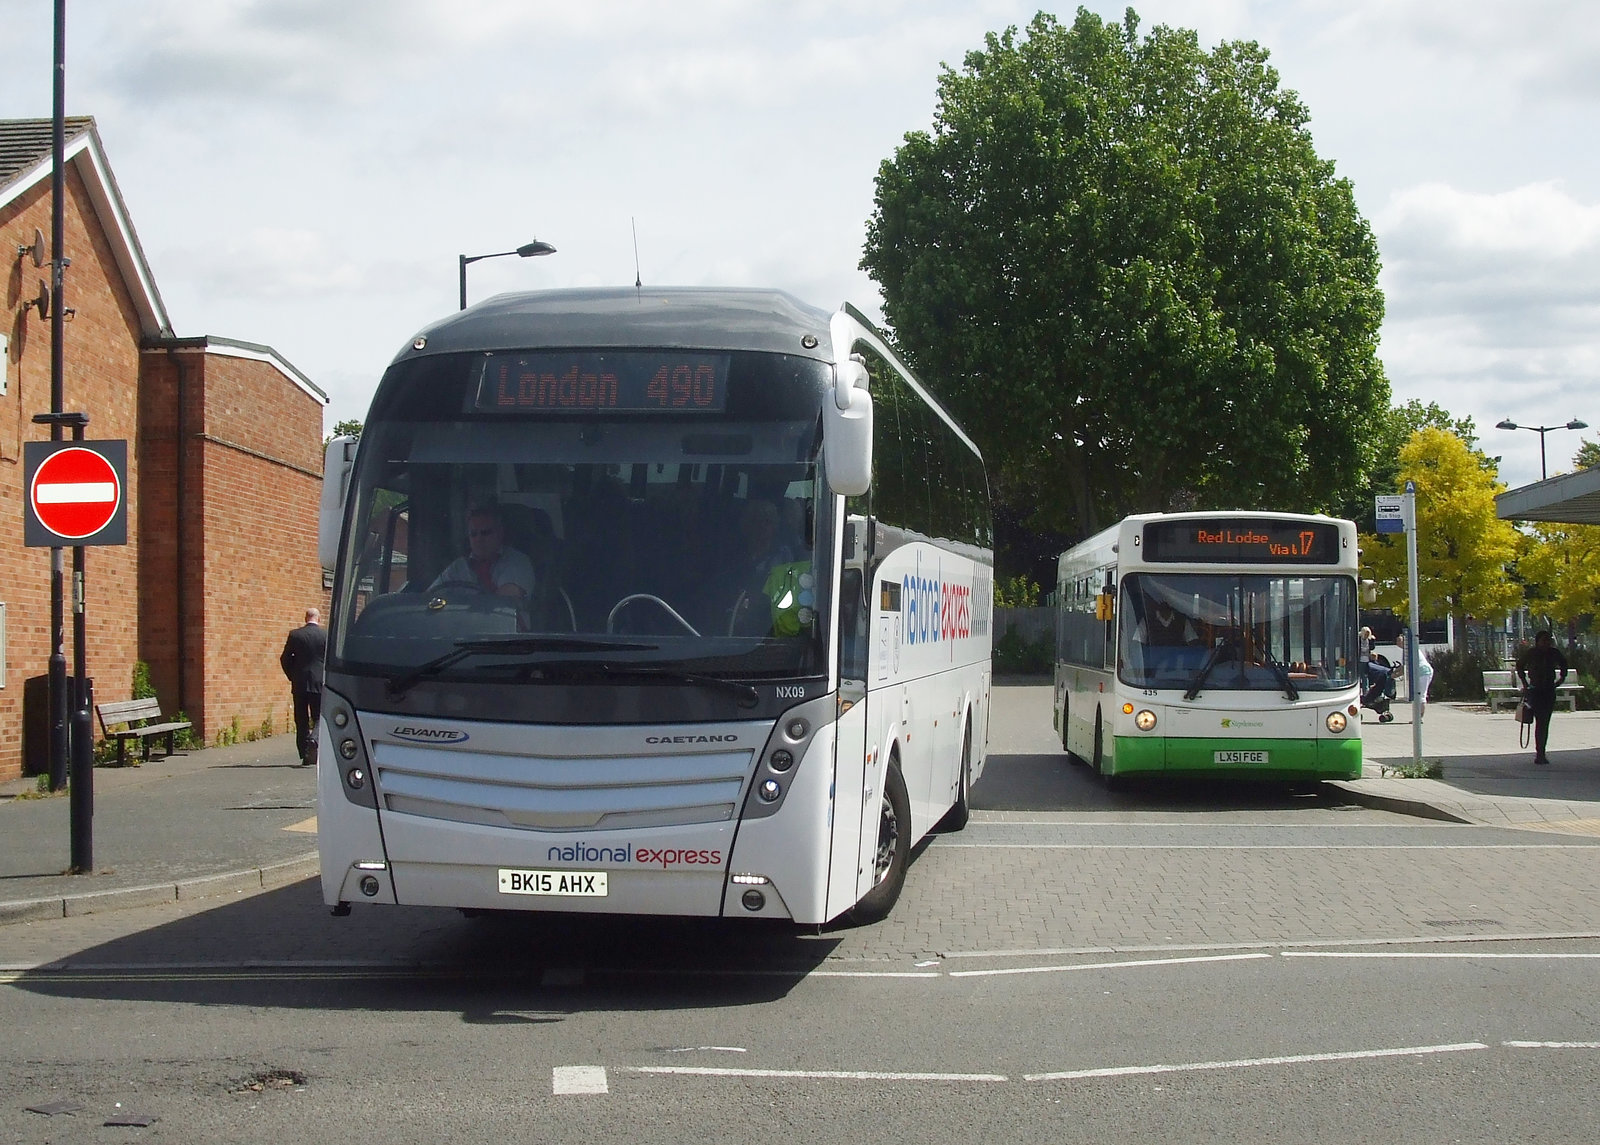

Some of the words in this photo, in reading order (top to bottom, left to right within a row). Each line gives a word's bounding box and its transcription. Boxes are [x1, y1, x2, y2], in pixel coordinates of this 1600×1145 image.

[497, 365, 618, 406] London
[646, 364, 715, 406] 490
[1406, 482, 1414, 490] A
[1198, 530, 1224, 543] Red
[1227, 530, 1269, 544] Lodge
[1299, 531, 1315, 555] 17
[1269, 543, 1289, 555] Via
[902, 552, 940, 645] national
[941, 581, 970, 661] express
[776, 686, 805, 699] NX09
[392, 726, 460, 741] LEVANTE
[645, 734, 738, 744] CAETANO
[548, 842, 631, 863] national
[635, 847, 721, 868] express
[510, 873, 552, 892] BK15
[558, 874, 595, 893] AHX
